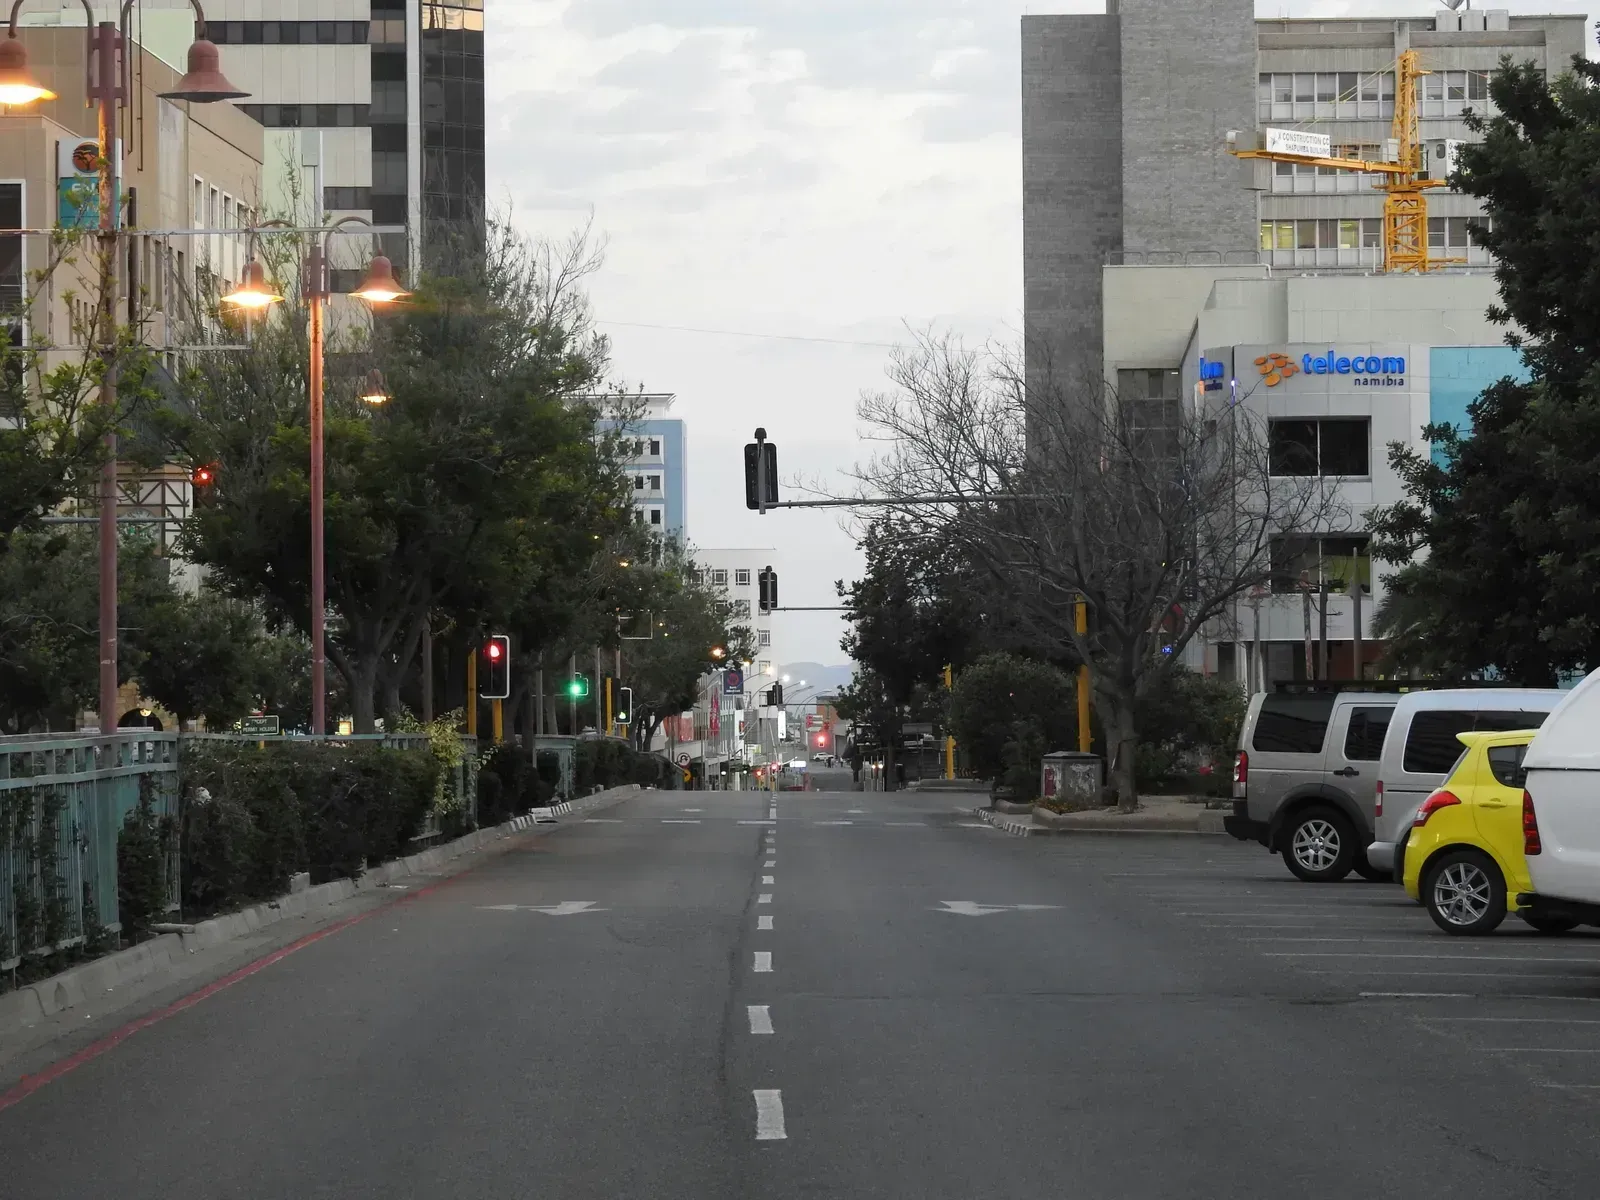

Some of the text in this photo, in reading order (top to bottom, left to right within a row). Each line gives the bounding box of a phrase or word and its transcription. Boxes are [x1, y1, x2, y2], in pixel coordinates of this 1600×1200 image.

[1282, 133, 1321, 145] CONSTRUCTION
[1302, 350, 1405, 374] telecom
[1354, 375, 1405, 386] namibia
